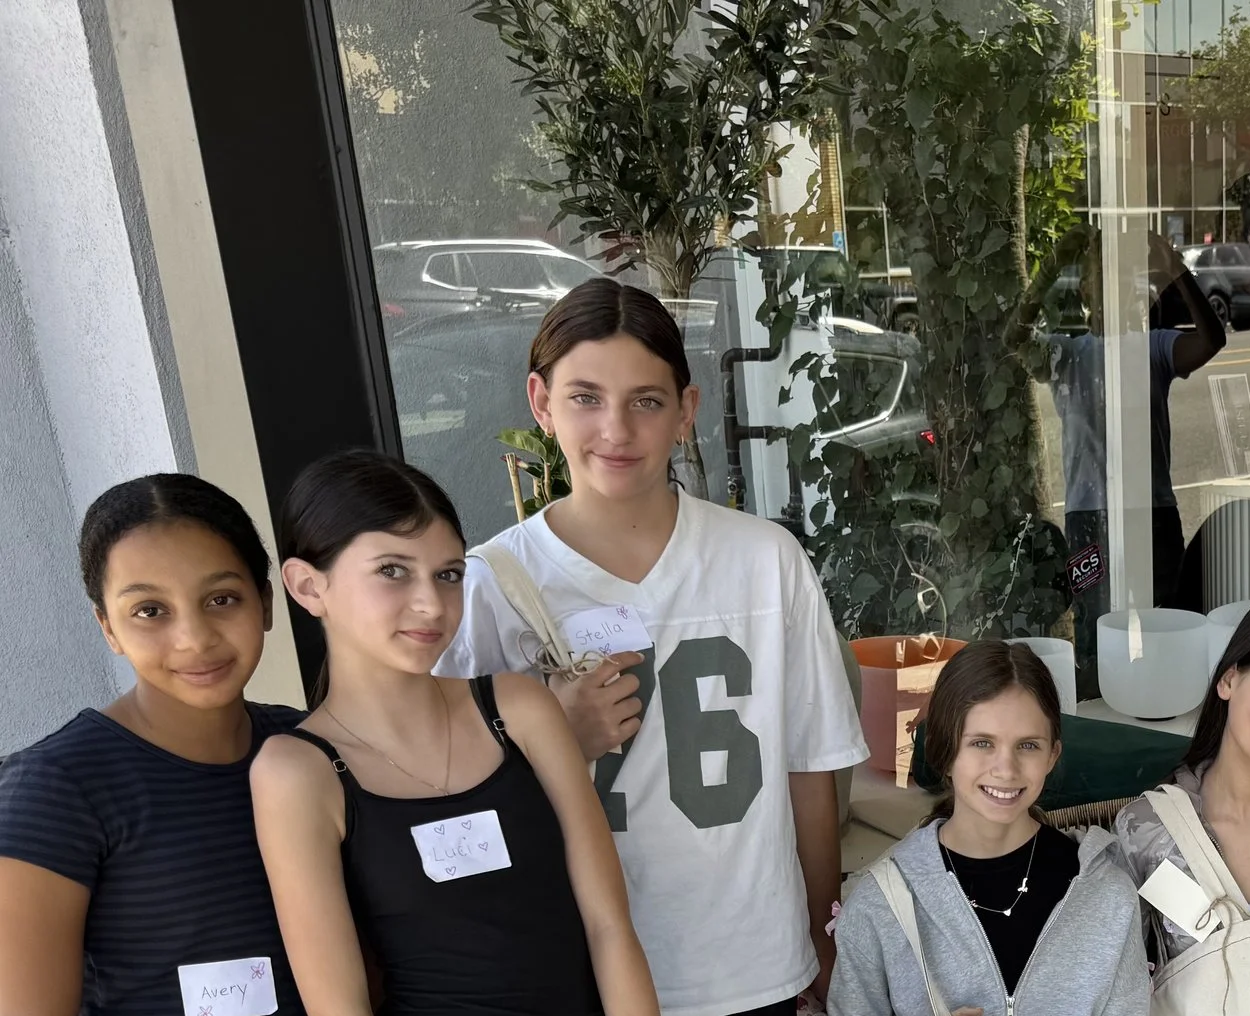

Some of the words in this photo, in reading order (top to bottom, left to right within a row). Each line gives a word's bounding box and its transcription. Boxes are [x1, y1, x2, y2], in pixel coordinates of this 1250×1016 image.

[1072, 553, 1099, 581] ACS
[575, 624, 624, 646] Stella
[433, 836, 472, 862] Luci
[201, 983, 248, 1005] Avery
